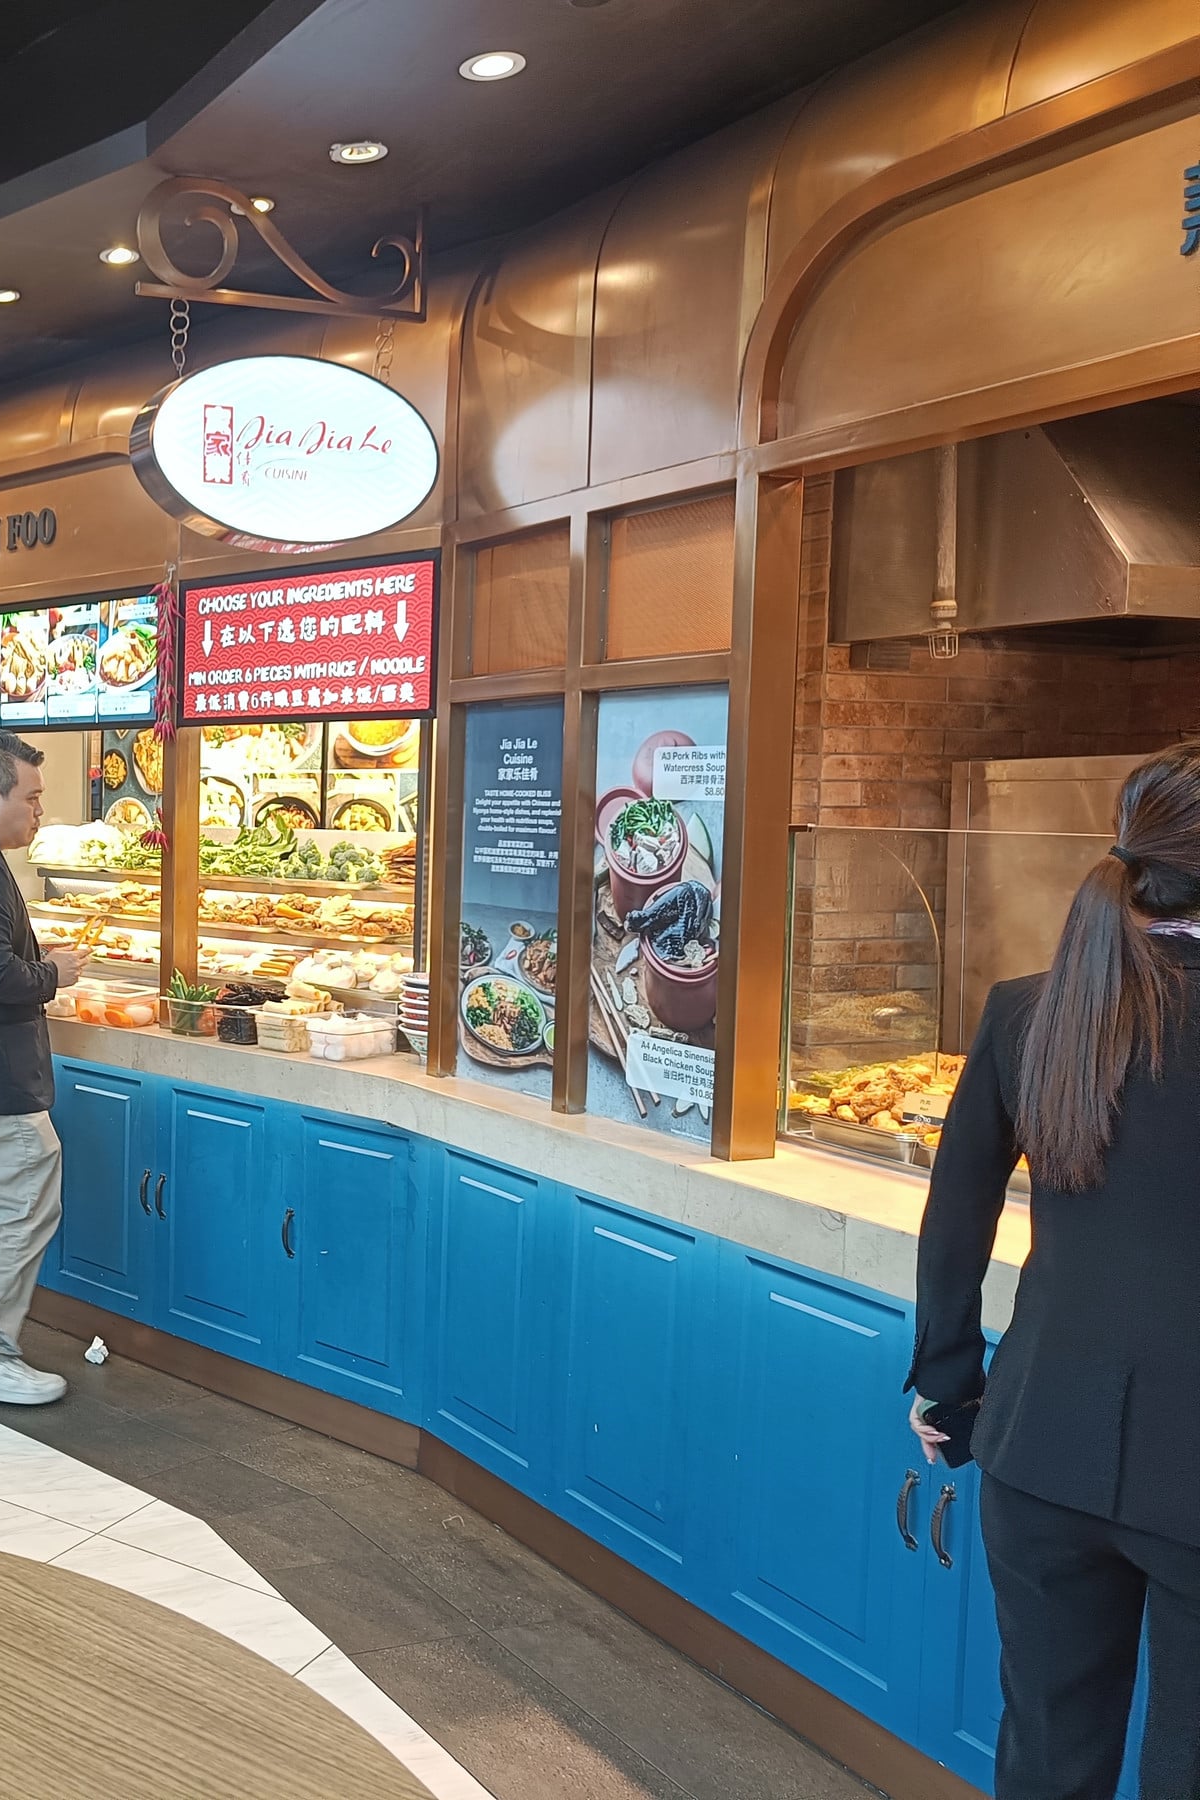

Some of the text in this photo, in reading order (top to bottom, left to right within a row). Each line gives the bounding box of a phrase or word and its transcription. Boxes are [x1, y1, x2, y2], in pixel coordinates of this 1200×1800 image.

[236, 415, 392, 456] Jia Jia Le
[6, 507, 57, 552] FOO
[198, 574, 416, 615] CHOOSE YOUR INGREDIENTS HERE
[188, 670, 207, 687] MIN
[207, 668, 243, 685] ORDER
[244, 667, 253, 683] 6
[253, 665, 292, 683] PIECES
[293, 661, 327, 680] WITH
[327, 660, 357, 678] RICE
[370, 655, 426, 675] NOODLE
[499, 737, 538, 750] Jia Jia Le
[503, 753, 534, 765] Cuisine
[661, 751, 726, 760] A3 Pork Ribs with
[663, 763, 726, 773] Watercress Soup
[641, 1041, 650, 1050] A4
[651, 1044, 683, 1057] Angelica
[642, 1053, 715, 1078] Black Chicken Soup
